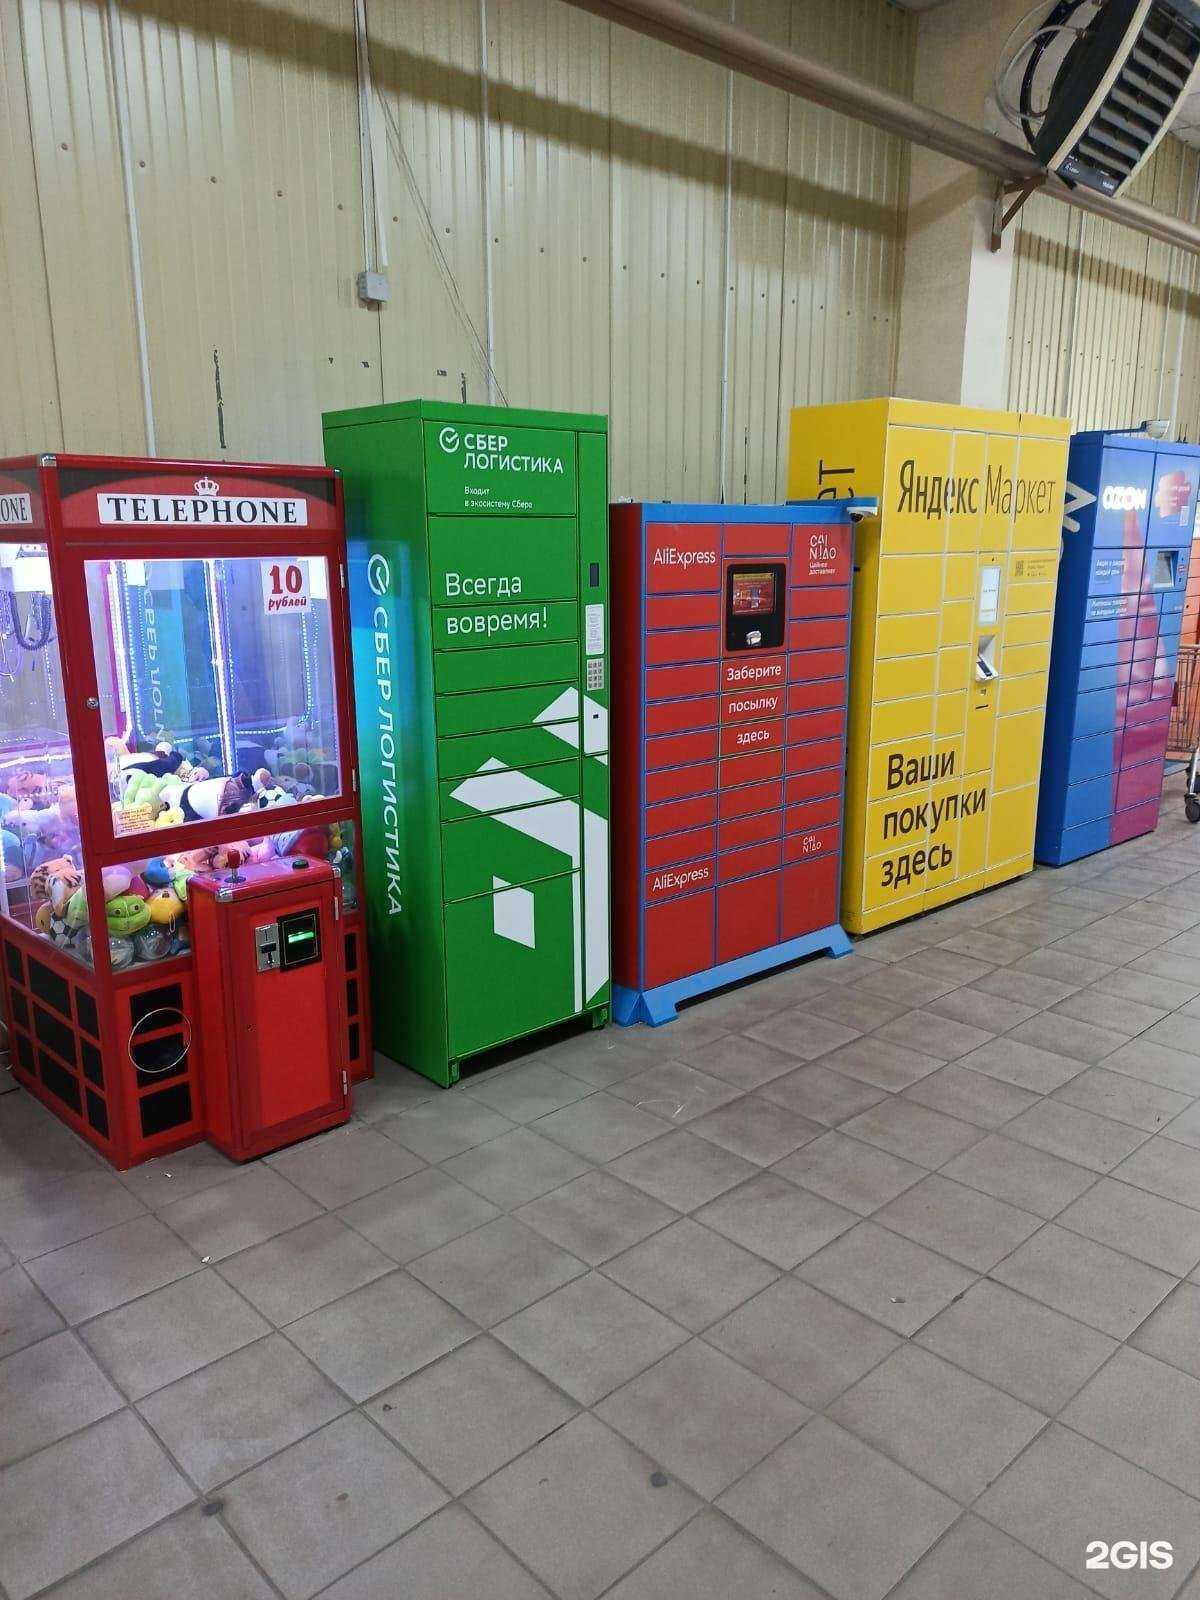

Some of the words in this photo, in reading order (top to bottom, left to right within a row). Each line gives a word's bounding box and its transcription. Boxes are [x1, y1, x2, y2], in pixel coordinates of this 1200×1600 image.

[464, 433, 508, 452] СБЕР
[464, 452, 564, 474] ЛОГИСТИКА
[464, 486, 490, 495] Входит
[897, 459, 979, 520] Яндекс
[984, 464, 1056, 523] Маркет
[107, 497, 297, 524] TELEPHONE
[653, 547, 716, 570] AliExpress
[270, 565, 302, 594] 10
[446, 572, 522, 597] Всегда
[268, 596, 307, 611] рублей
[447, 606, 547, 637] вовремя!
[373, 606, 392, 701] СБЕР
[727, 664, 782, 681] Заберите
[728, 696, 778, 714] посылку
[736, 729, 770, 744] здесь
[887, 751, 955, 790] Ваши
[378, 705, 402, 915] ЛОГИСТИКА
[883, 788, 986, 840] покупки
[881, 843, 953, 889] здесь
[652, 867, 709, 892] AliExpress
